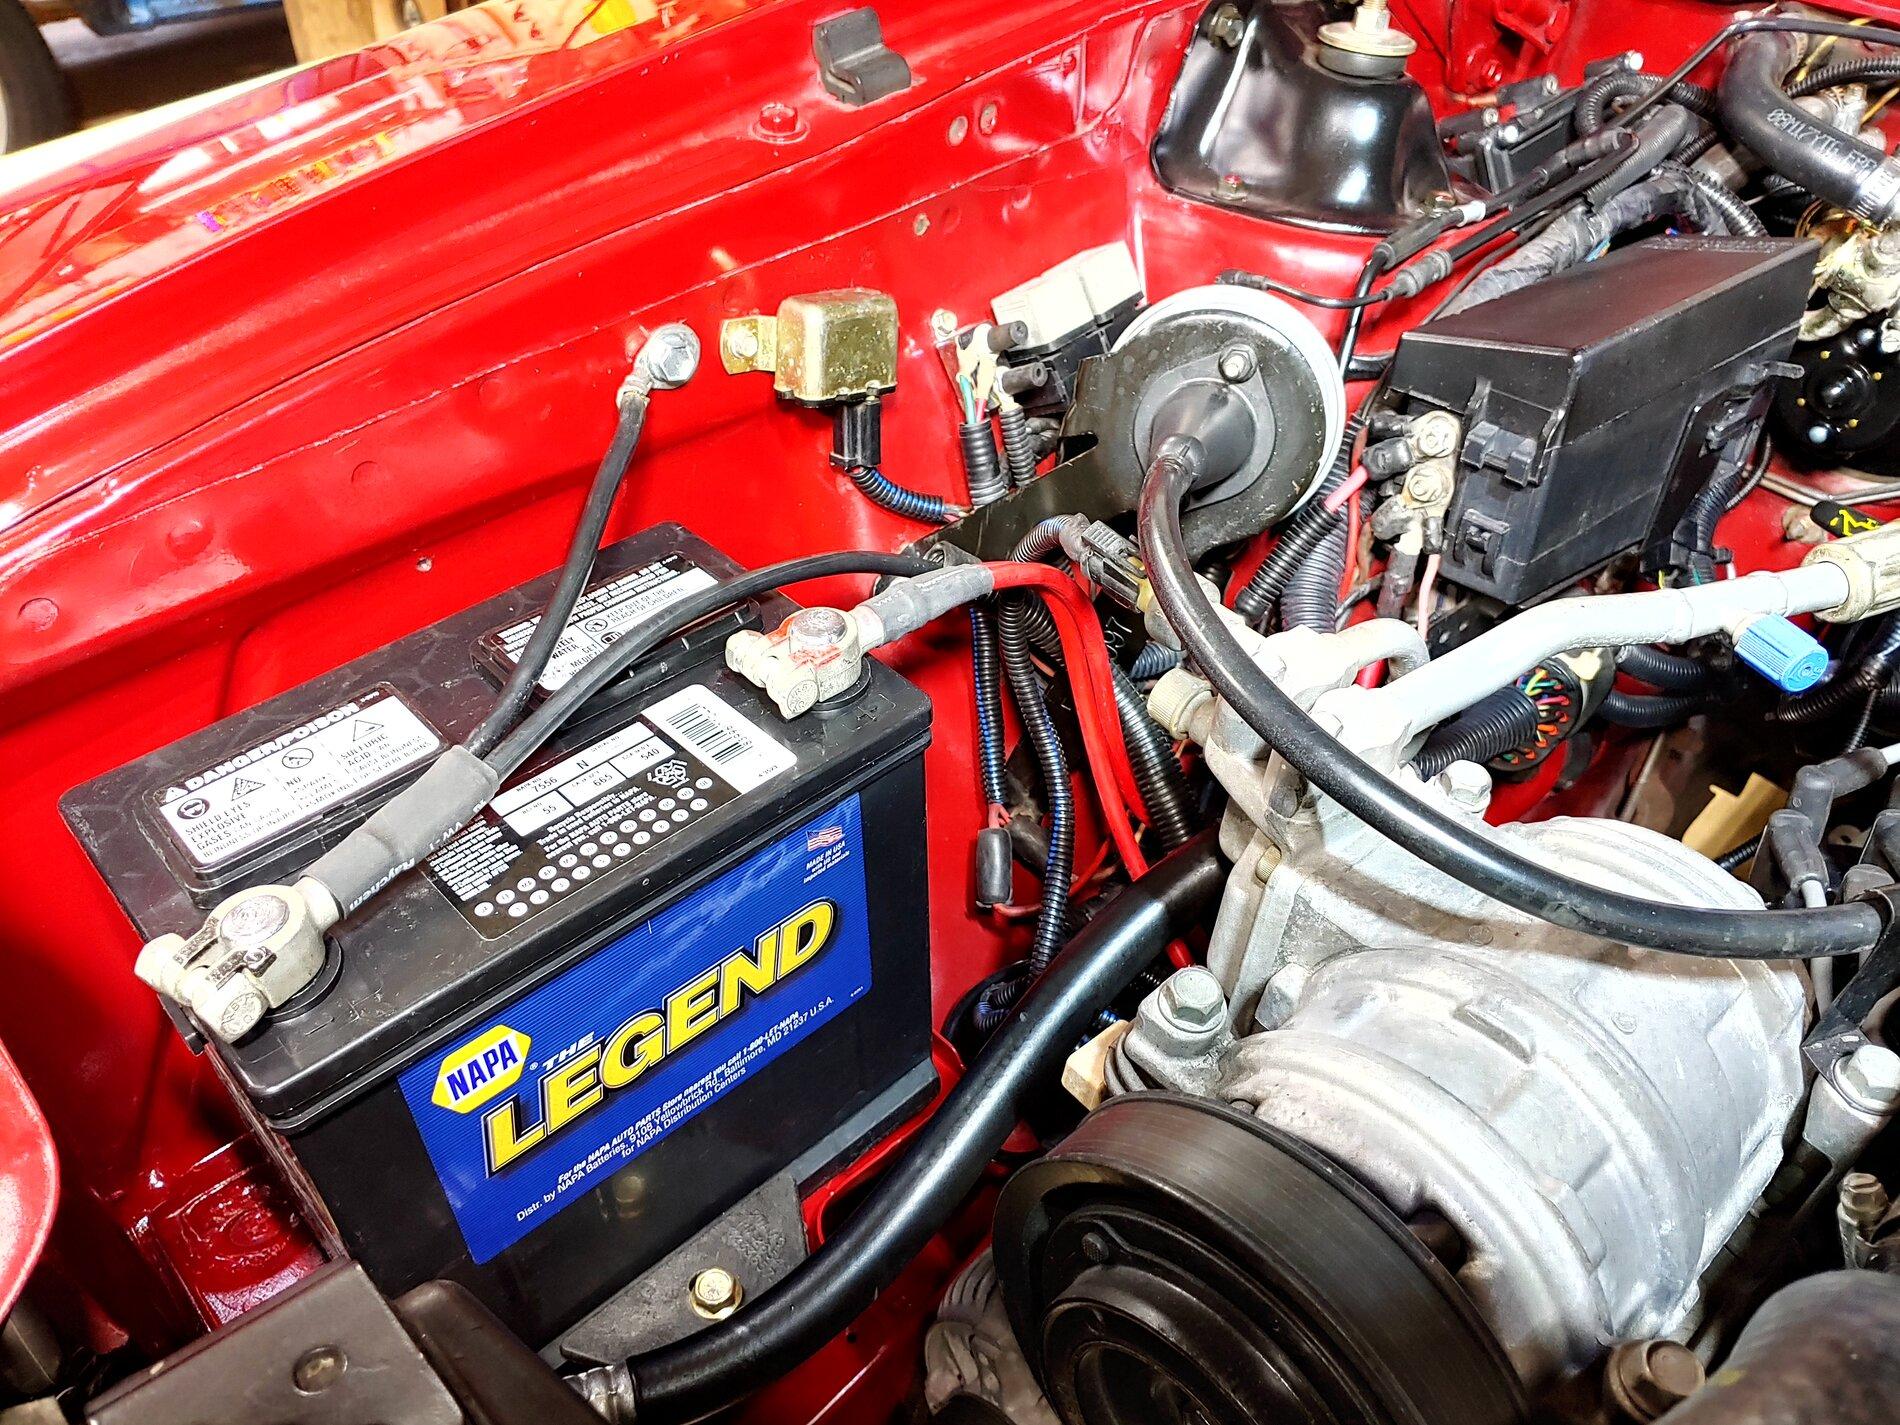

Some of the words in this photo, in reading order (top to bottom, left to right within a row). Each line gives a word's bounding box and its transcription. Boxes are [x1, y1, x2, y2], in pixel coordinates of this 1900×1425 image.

[576, 759, 589, 769] N
[640, 748, 659, 759] 540
[532, 778, 557, 792] 7556
[592, 774, 612, 785] 665
[185, 815, 221, 835] SHIELD
[223, 801, 250, 816] EYES
[542, 805, 556, 814] 55
[191, 813, 245, 842] EXPLOSIVE
[196, 830, 231, 850] GASES
[806, 853, 824, 870] MADE
[824, 848, 832, 858] IN
[832, 840, 845, 853] USA
[350, 857, 415, 911] Raychem
[482, 898, 837, 1176] LEGEND
[542, 1031, 595, 1071] THE
[447, 1039, 518, 1101] NAPA
[516, 1201, 542, 1221] Distr.
[543, 1190, 555, 1203] by
[557, 1170, 585, 1193] NAPA
[585, 1141, 628, 1173] Batteries,
[629, 1121, 652, 1143] 9108
[652, 1083, 704, 1124] Yellowbrick
[723, 1043, 765, 1077] Baltimore,
[766, 1031, 781, 1047] MD
[782, 1011, 807, 1035] 21237
[809, 996, 834, 1016] U.S.A.
[558, 1169, 571, 1183] For
[570, 1159, 586, 1173] the
[587, 1142, 610, 1163] NAPA
[611, 1125, 633, 1147] AUTO
[634, 1106, 661, 1130] PARTS
[662, 1093, 682, 1111] Store
[683, 1071, 711, 1096] nearest
[712, 1062, 727, 1078] you
[727, 1050, 741, 1066] call
[742, 1010, 799, 1055] 1-800-LET-NAPA
[621, 1144, 634, 1157] for
[636, 1125, 662, 1147] NAPA
[663, 1090, 712, 1128] Distribution
[714, 1066, 746, 1092] Centers
